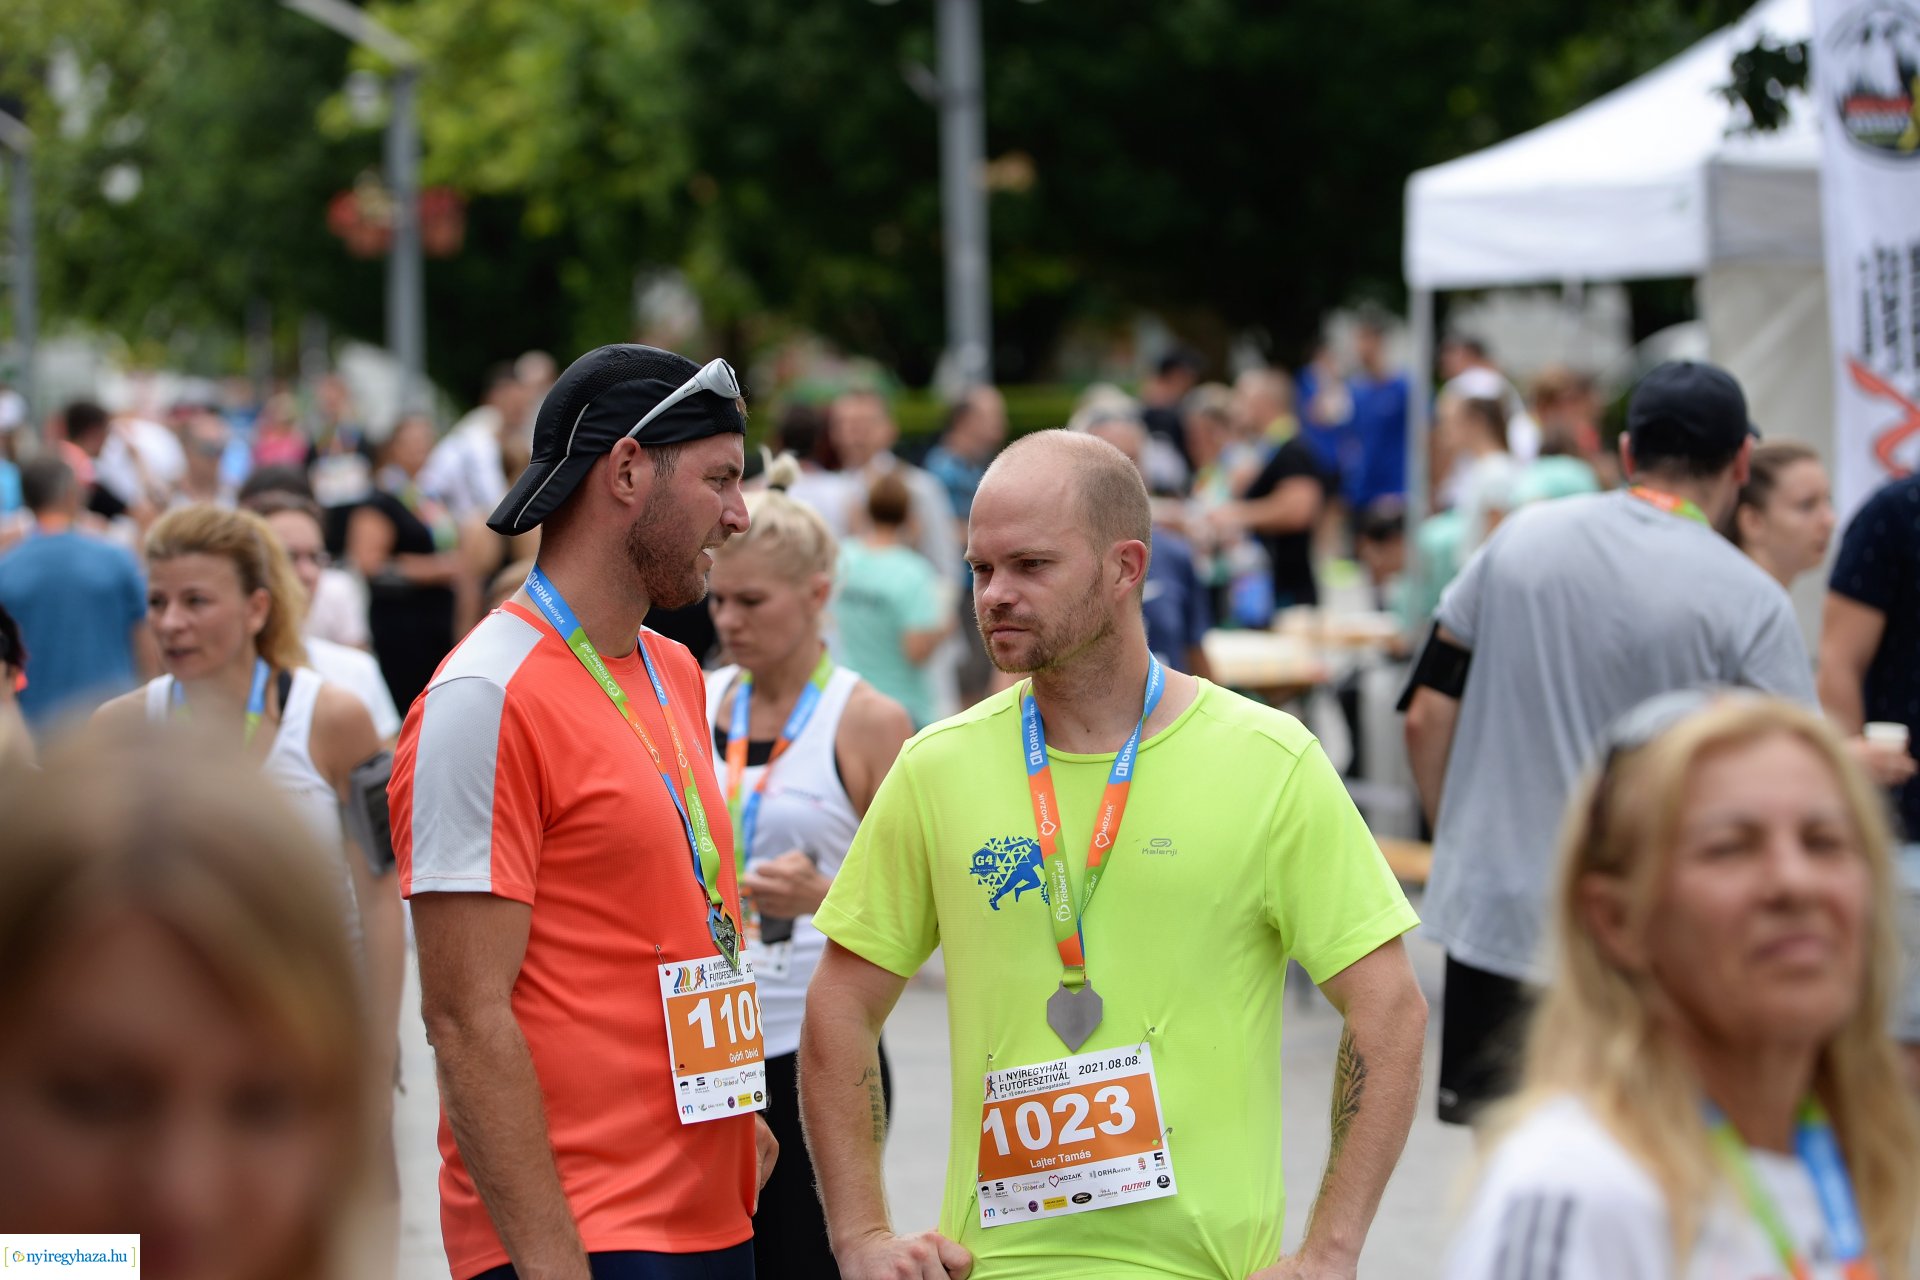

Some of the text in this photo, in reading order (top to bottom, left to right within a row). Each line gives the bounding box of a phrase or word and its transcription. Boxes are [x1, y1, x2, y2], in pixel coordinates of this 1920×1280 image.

[1038, 792, 1047, 822] MOZAIK
[1102, 803, 1114, 834] MOZAIK
[975, 854, 993, 866] G4
[1141, 847, 1178, 856] Kalenji
[1060, 874, 1069, 903] Többet
[1006, 1061, 1068, 1081] NYÍREGYHÁZI
[1078, 1055, 1141, 1075] 2021.08.08.
[999, 1070, 1070, 1093] FUTÓFESZTIVÁL
[982, 1085, 1136, 1156] 1023
[1029, 1149, 1092, 1169] Lajter Tamás
[1059, 1173, 1082, 1182] MOZAIK
